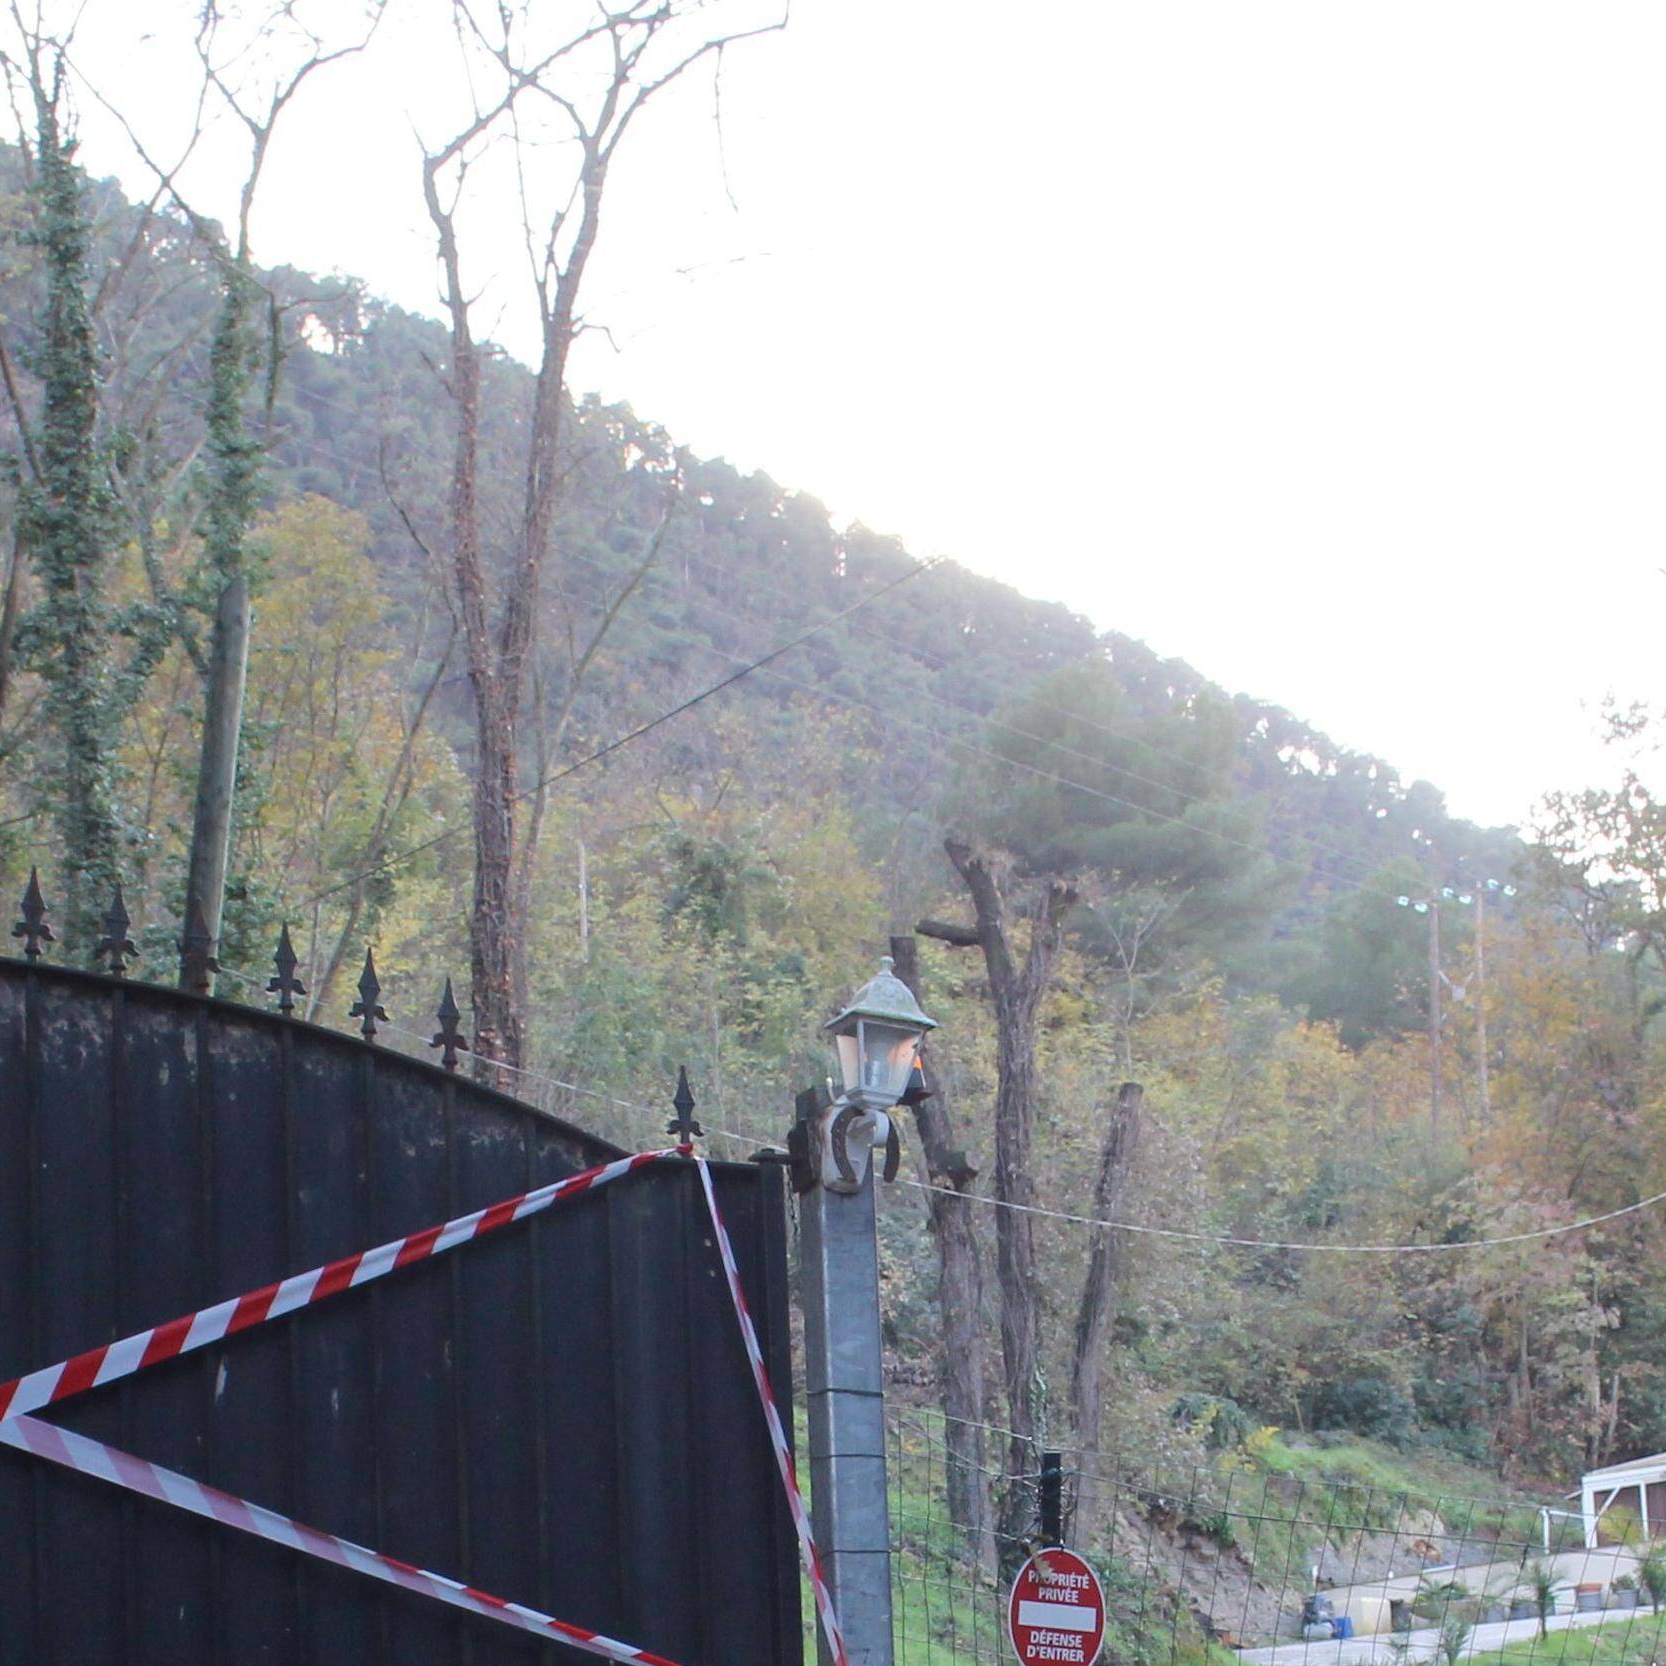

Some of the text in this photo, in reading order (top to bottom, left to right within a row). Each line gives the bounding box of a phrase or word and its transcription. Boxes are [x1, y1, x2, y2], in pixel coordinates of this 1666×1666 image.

[1038, 1587, 1079, 1603] PRIVÉE
[1030, 1629, 1083, 1648] DÉFENSE
[1027, 1645, 1085, 1663] D'ENTRER
